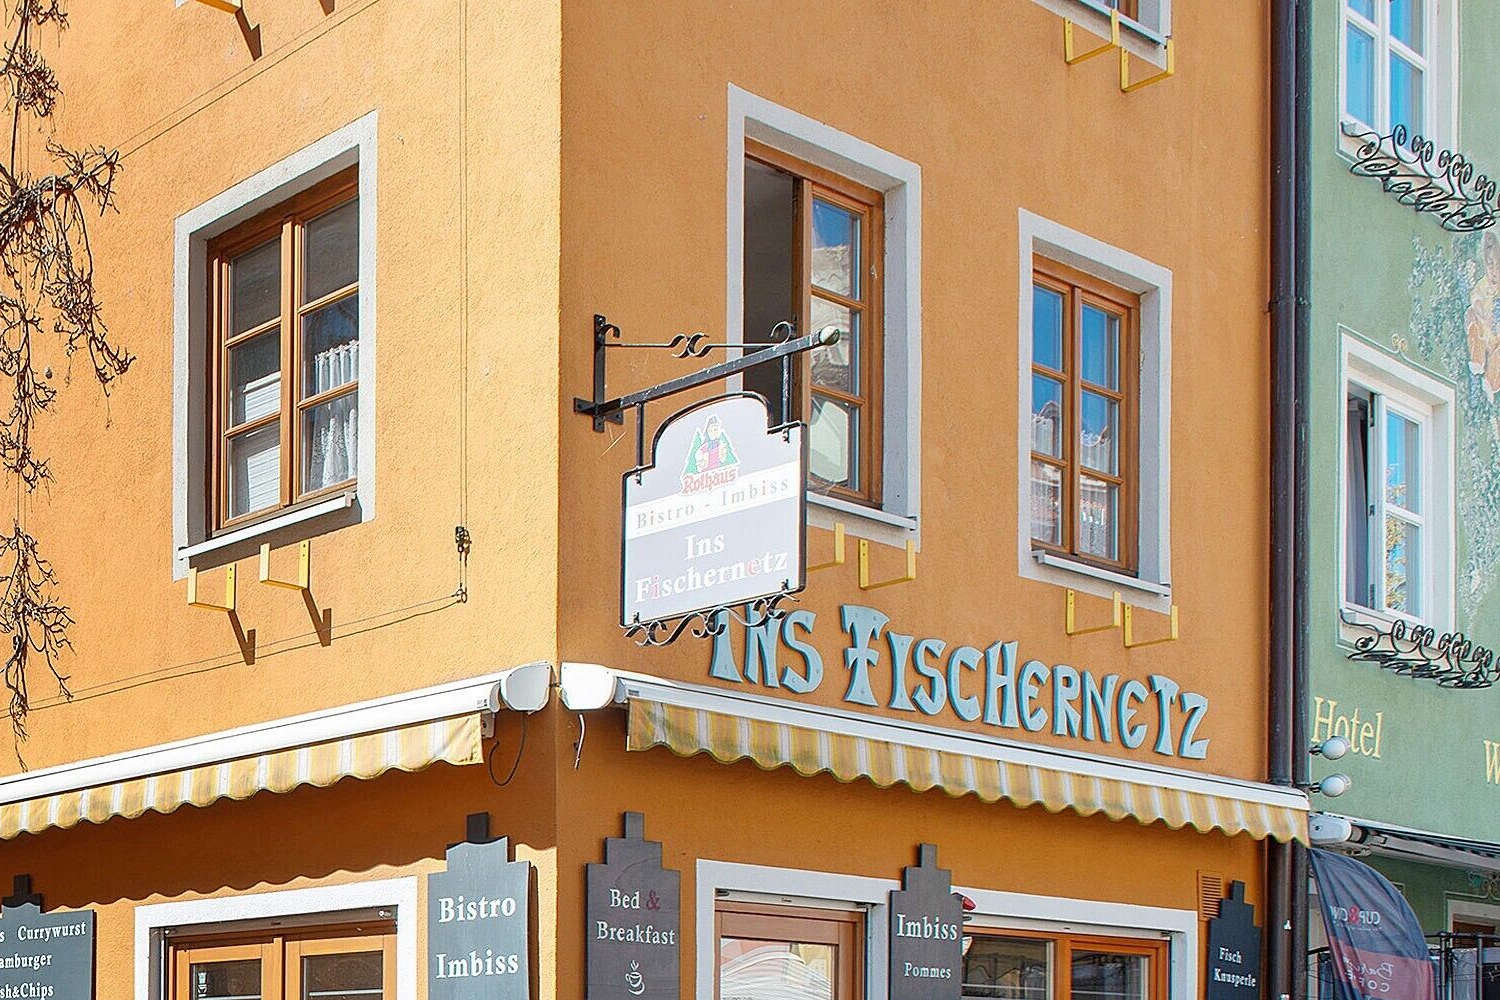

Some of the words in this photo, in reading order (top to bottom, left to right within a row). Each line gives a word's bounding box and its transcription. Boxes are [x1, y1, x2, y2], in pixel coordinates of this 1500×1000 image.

[682, 468, 737, 494] Rothaus
[636, 505, 694, 529] Bistro
[722, 478, 789, 506] Imbiss
[684, 534, 725, 561] Ins
[635, 552, 788, 603] Fischernetz
[1311, 696, 1384, 760] Hotel
[438, 895, 516, 923] Bistro
[609, 888, 641, 909] Bed
[646, 890, 660, 911] &
[17, 921, 87, 941] Currywurst
[596, 921, 675, 945] Breakfast
[896, 913, 958, 941] Imbiss
[435, 948, 519, 979] Imbiss
[1218, 947, 1242, 964] Fisch
[904, 962, 952, 979] Pommes
